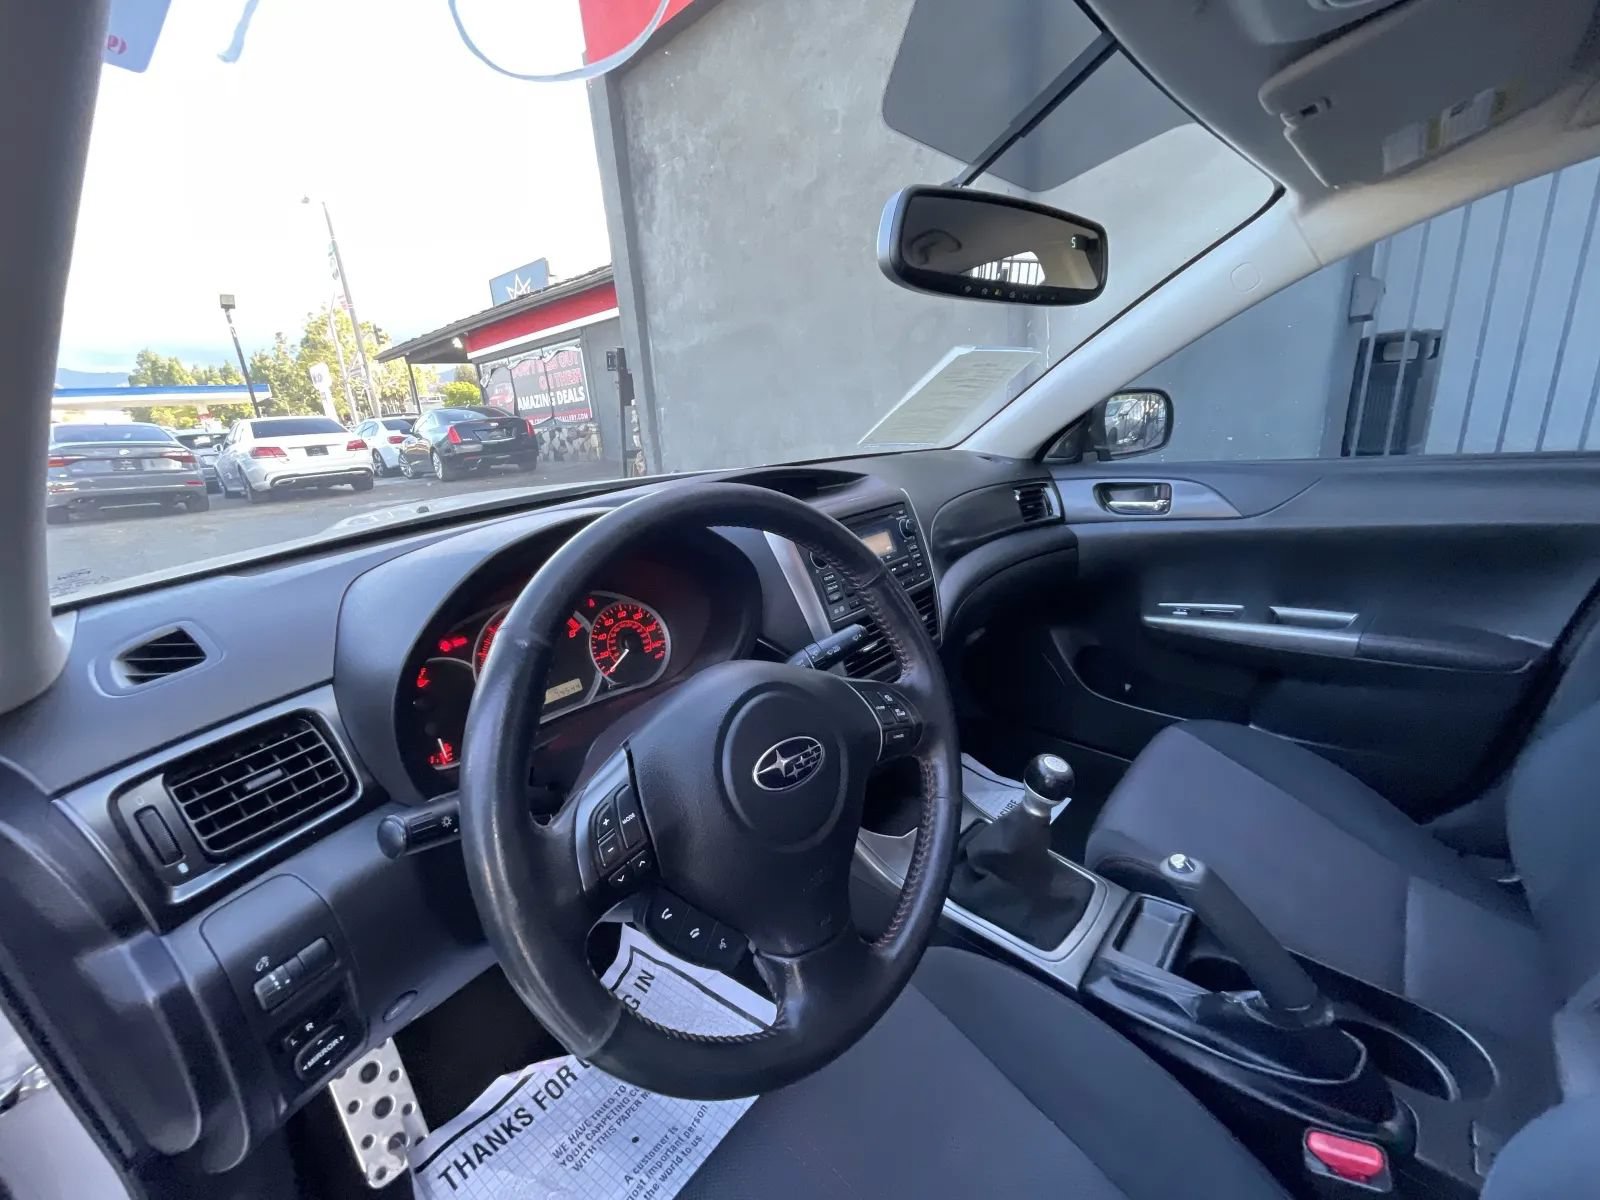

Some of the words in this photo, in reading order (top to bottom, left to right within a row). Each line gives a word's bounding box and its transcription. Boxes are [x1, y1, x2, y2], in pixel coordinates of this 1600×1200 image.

[517, 392, 555, 410] AMAZING
[556, 386, 585, 404] DEALS
[622, 812, 635, 824] MODE
[305, 1022, 315, 1031] R
[307, 1039, 339, 1068] MIRROR
[437, 1106, 535, 1192] THANKS
[532, 1064, 578, 1111] FOR
[633, 969, 656, 993] IN
[552, 1142, 569, 1160] WE
[568, 1119, 592, 1145] HAVE
[591, 1097, 615, 1121] TRIED
[614, 1084, 627, 1097] TO
[560, 1142, 586, 1168] YOUR
[585, 1096, 630, 1141] CARPETING
[572, 1145, 597, 1172] WITH
[596, 1125, 617, 1145] THIS
[616, 1101, 642, 1127] PAPER
[646, 1136, 685, 1180] important
[683, 1104, 709, 1139] person
[624, 1174, 634, 1185] A
[632, 1133, 670, 1175] customer
[667, 1126, 679, 1136] is
[643, 1183, 660, 1200] the
[658, 1155, 684, 1182] world
[681, 1147, 692, 1158] to
